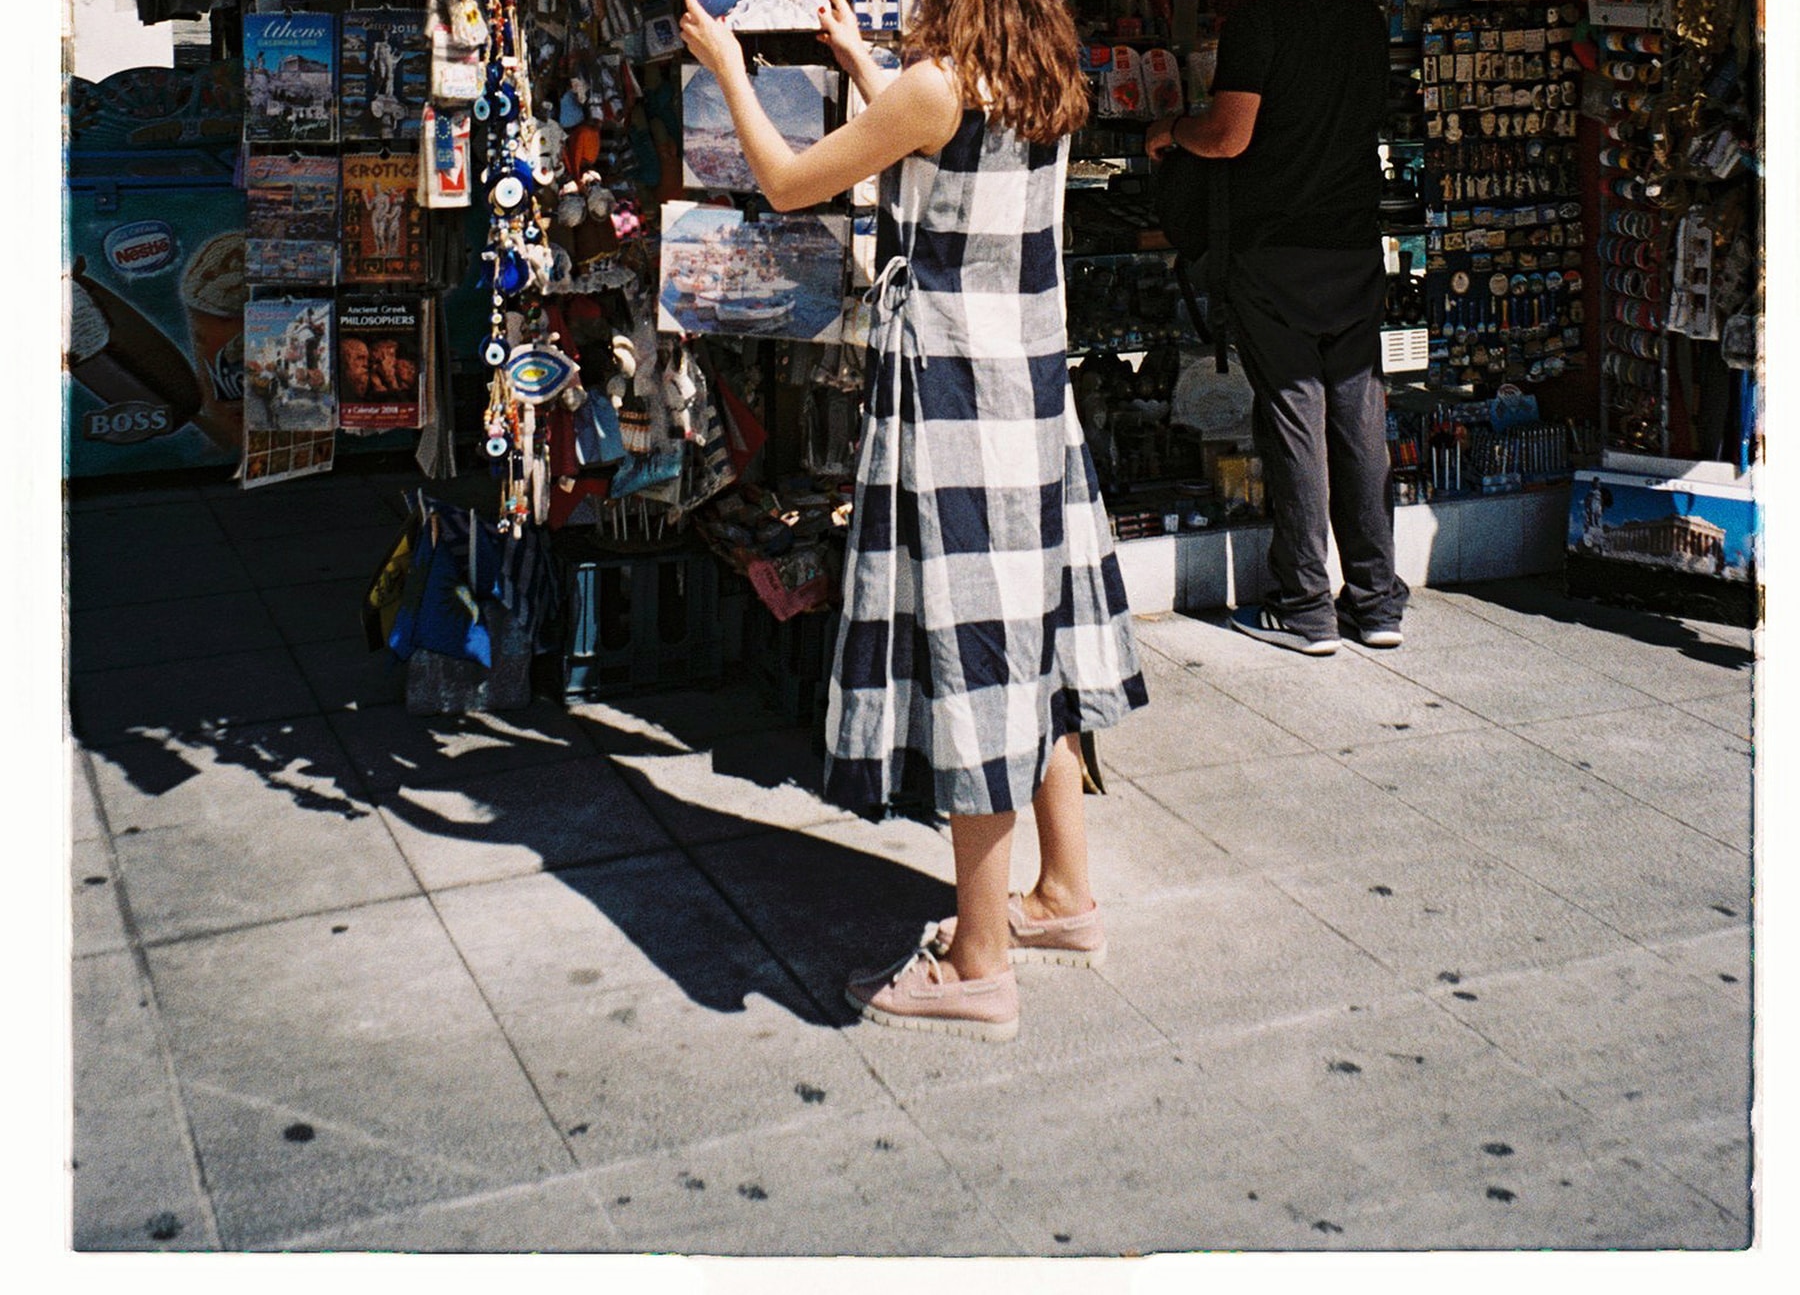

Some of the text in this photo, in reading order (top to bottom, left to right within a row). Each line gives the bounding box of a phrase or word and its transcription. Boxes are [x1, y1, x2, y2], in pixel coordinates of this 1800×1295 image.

[261, 20, 327, 38] Athens
[350, 163, 418, 178] EROTICA
[347, 305, 406, 314] Ancient Greek
[340, 315, 415, 326] PHILOSOPHERS
[90, 408, 168, 435] BOSS
